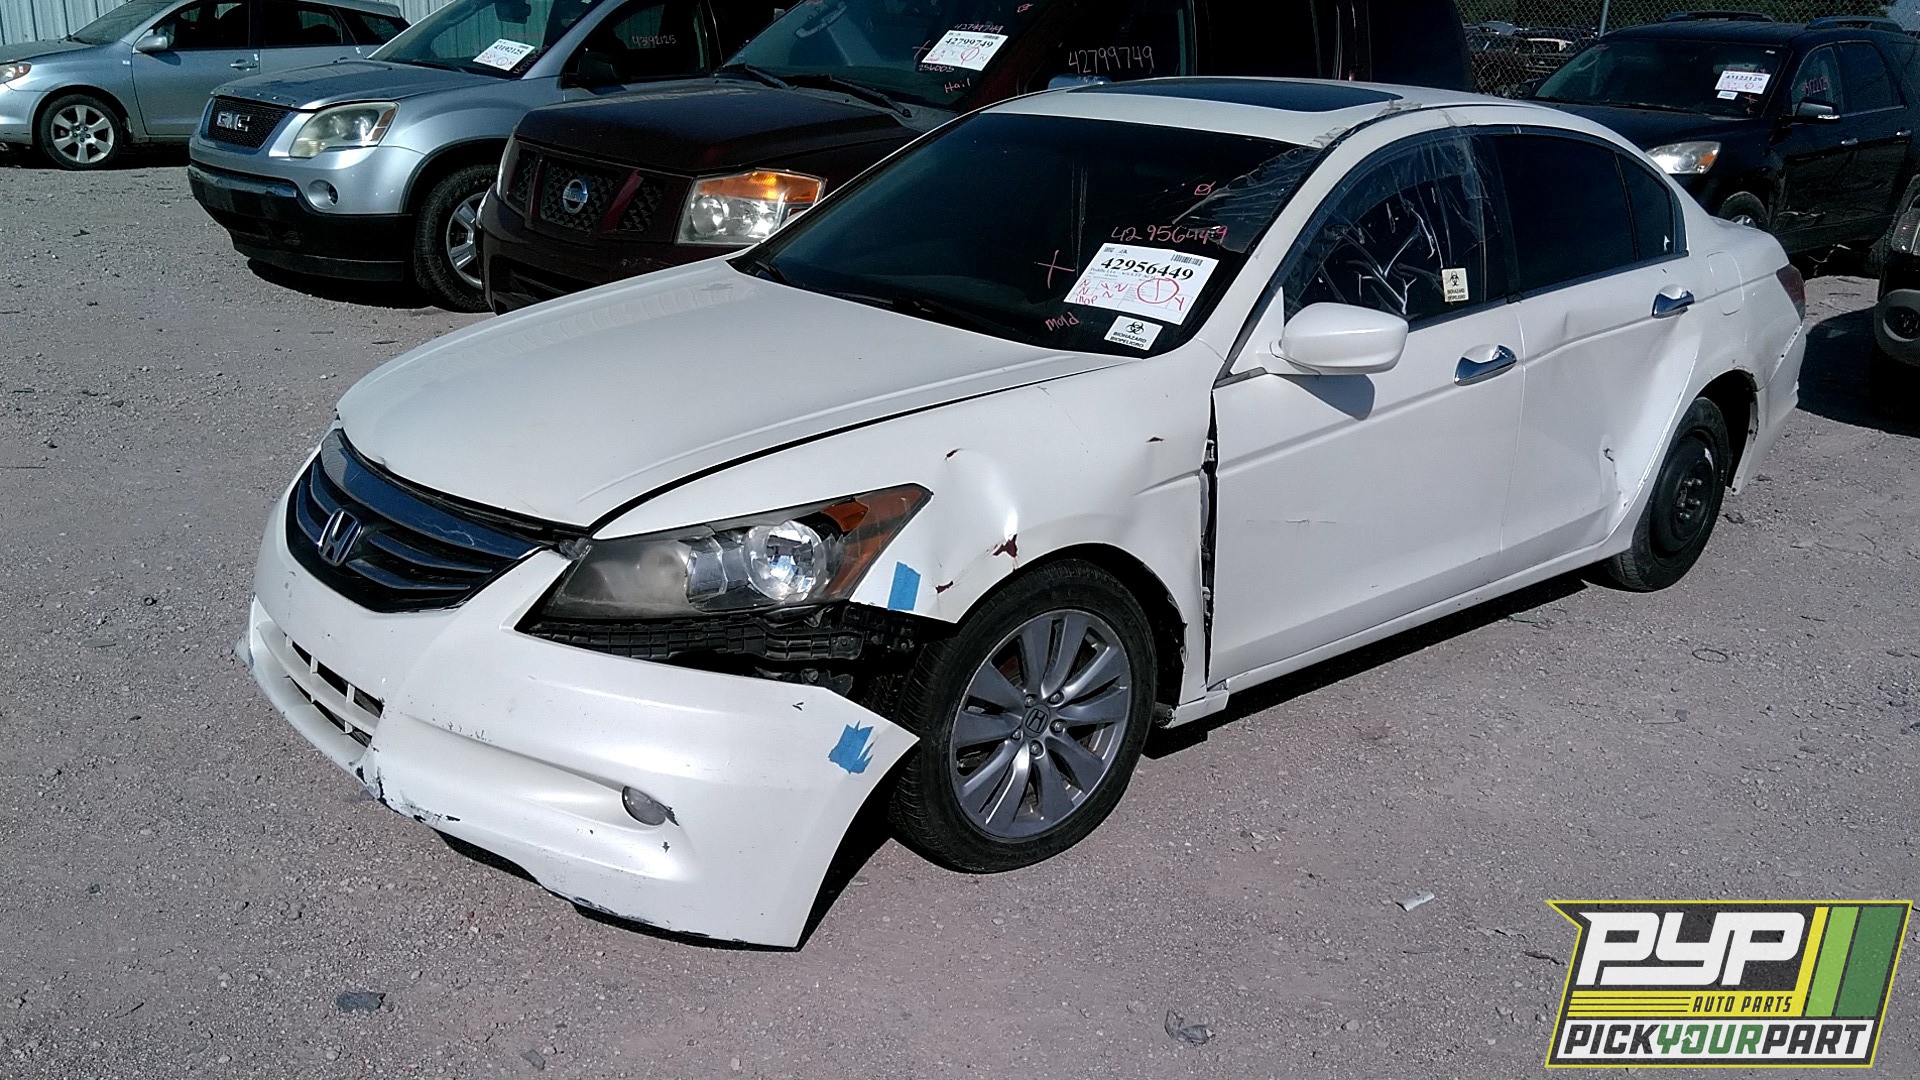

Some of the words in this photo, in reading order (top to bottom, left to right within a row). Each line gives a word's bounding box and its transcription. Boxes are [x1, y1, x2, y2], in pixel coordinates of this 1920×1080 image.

[1068, 45, 1155, 75] 42799749
[944, 77, 971, 94] Hail
[1101, 257, 1194, 281] 42956449
[1112, 331, 1147, 344] BIOHAZARD
